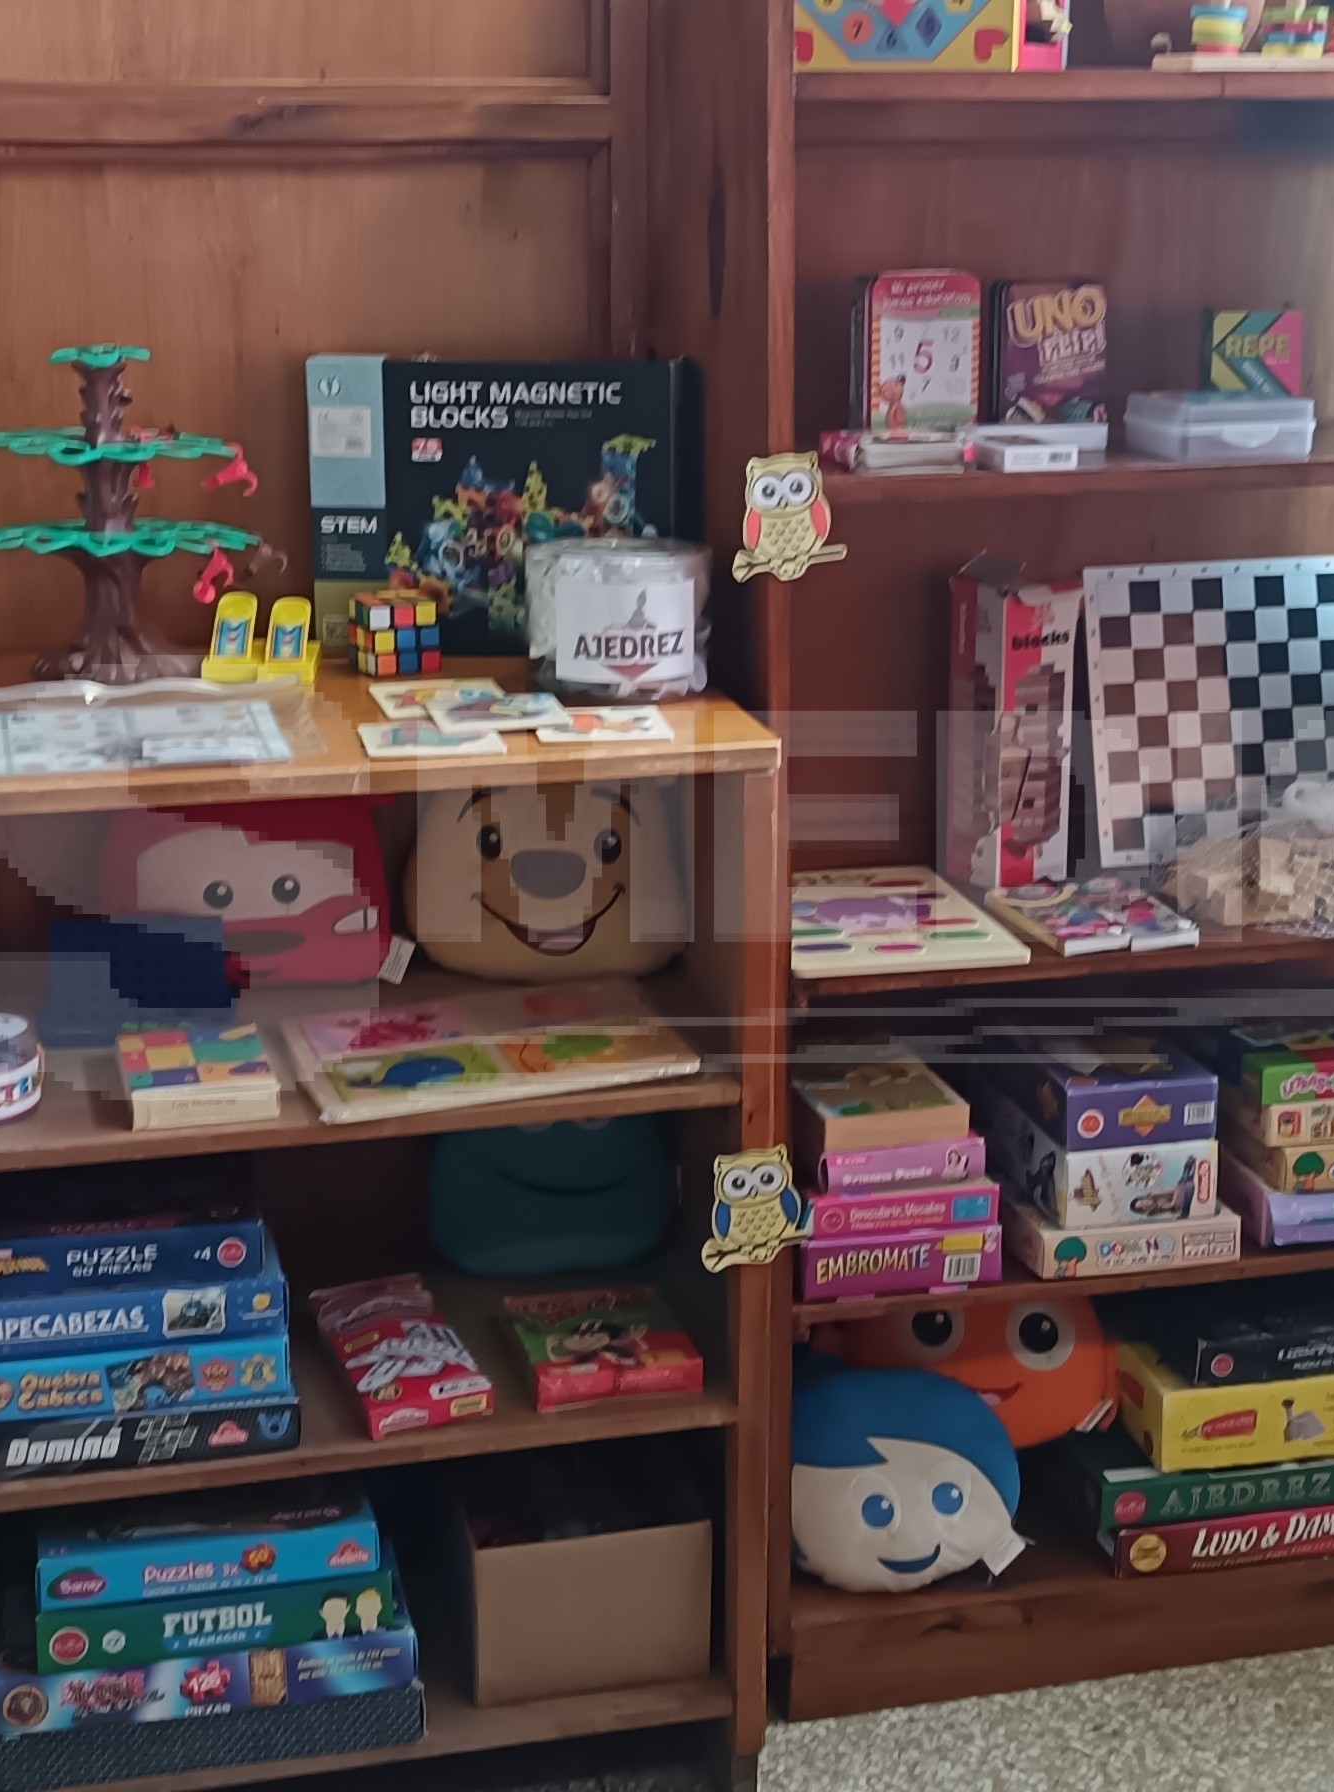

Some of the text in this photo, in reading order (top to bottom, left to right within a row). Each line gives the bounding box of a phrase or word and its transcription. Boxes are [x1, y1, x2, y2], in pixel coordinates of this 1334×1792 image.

[1008, 284, 1106, 345] UNO
[913, 339, 935, 374] 5
[1224, 334, 1292, 359] REPE
[409, 380, 623, 405] LIGHT MAGNETIC
[410, 405, 509, 429] BLOCKS
[320, 515, 378, 534] STEM
[573, 630, 685, 660] AJEDREZ
[1011, 629, 1071, 651] blocks
[67, 1244, 158, 1266] PUZZLE
[816, 1243, 931, 1285] EMBROMATE
[20, 1370, 100, 1391] Quebra
[1160, 1472, 1332, 1516] AJEDREZ
[1192, 1527, 1258, 1558] LUDO
[1260, 1522, 1281, 1549] &
[144, 1561, 215, 1585] Puzzles
[163, 1602, 273, 1637] FUTBOL
[188, 1631, 246, 1646] MANAGER
